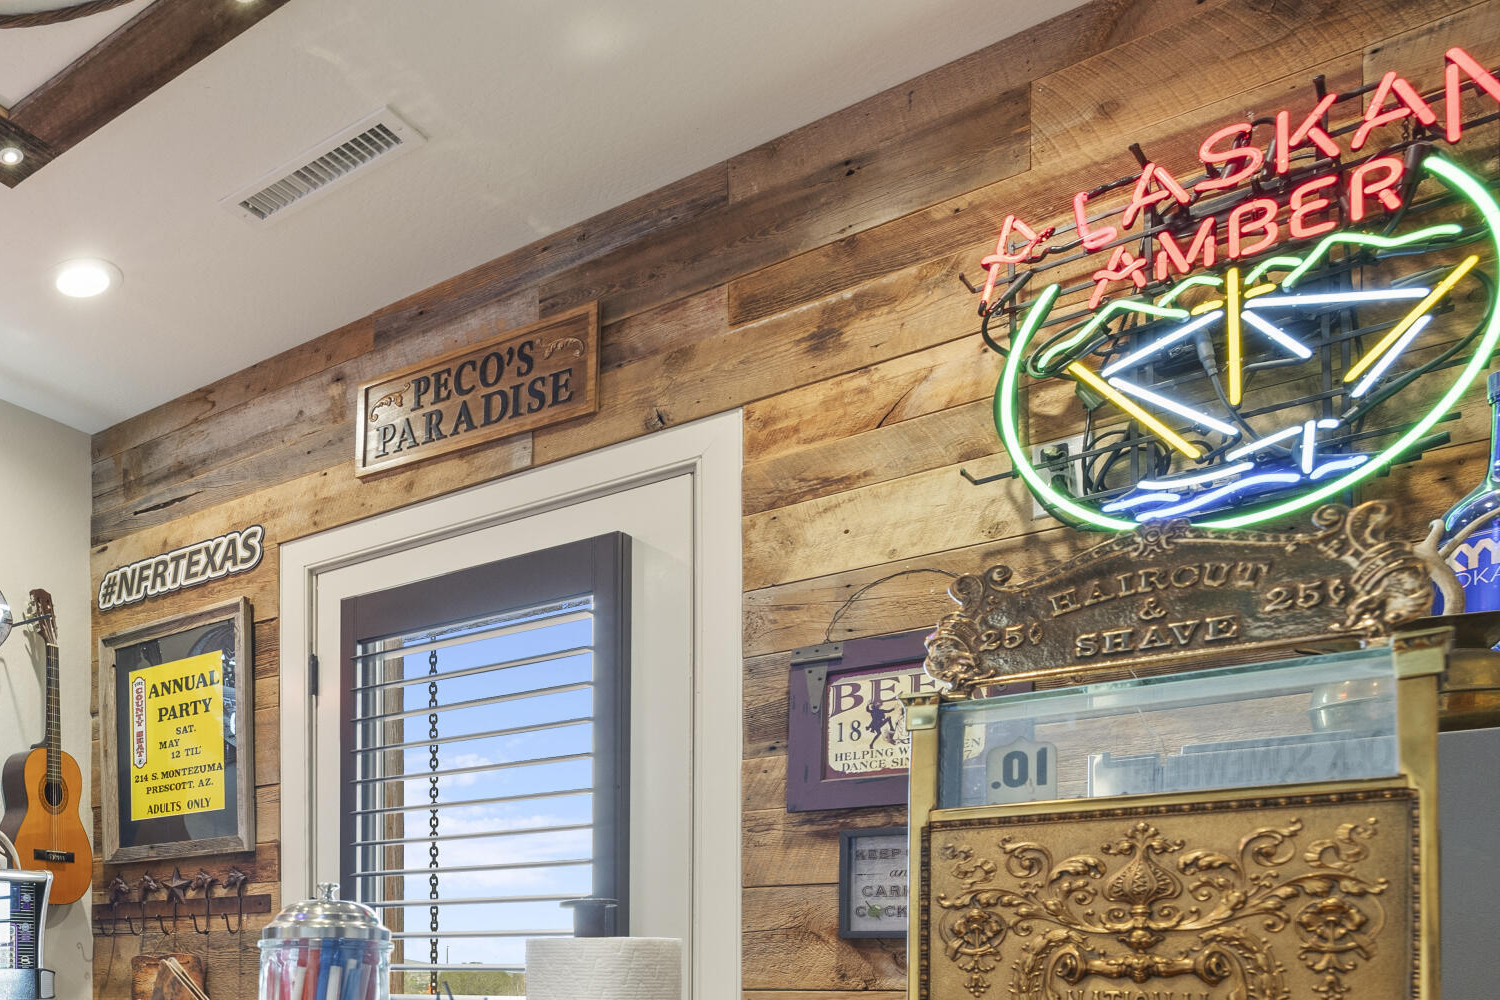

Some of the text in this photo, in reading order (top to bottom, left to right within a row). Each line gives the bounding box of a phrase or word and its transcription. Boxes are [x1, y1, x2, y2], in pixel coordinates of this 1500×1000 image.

[1088, 157, 1404, 310] AMBER
[410, 340, 535, 412] PECO'S
[375, 368, 573, 459] PARADISE
[100, 526, 262, 607] #NFRTEXAS
[1050, 559, 1273, 617] HAIRCUT
[1139, 597, 1167, 621] &
[1075, 615, 1238, 659] SHAVE
[148, 670, 220, 699] ANNUAL
[157, 697, 213, 722] PARTY
[175, 724, 196, 735] SAT.
[159, 739, 180, 750] MAY
[171, 750, 181, 759] 12
[835, 747, 894, 762] HELPING
[134, 762, 223, 783] 214 S. MONTEZUMA
[842, 758, 886, 772] DANCE
[991, 747, 1048, 789] .01
[197, 777, 214, 788] AZ.
[147, 797, 211, 815] ADULTS ONLY
